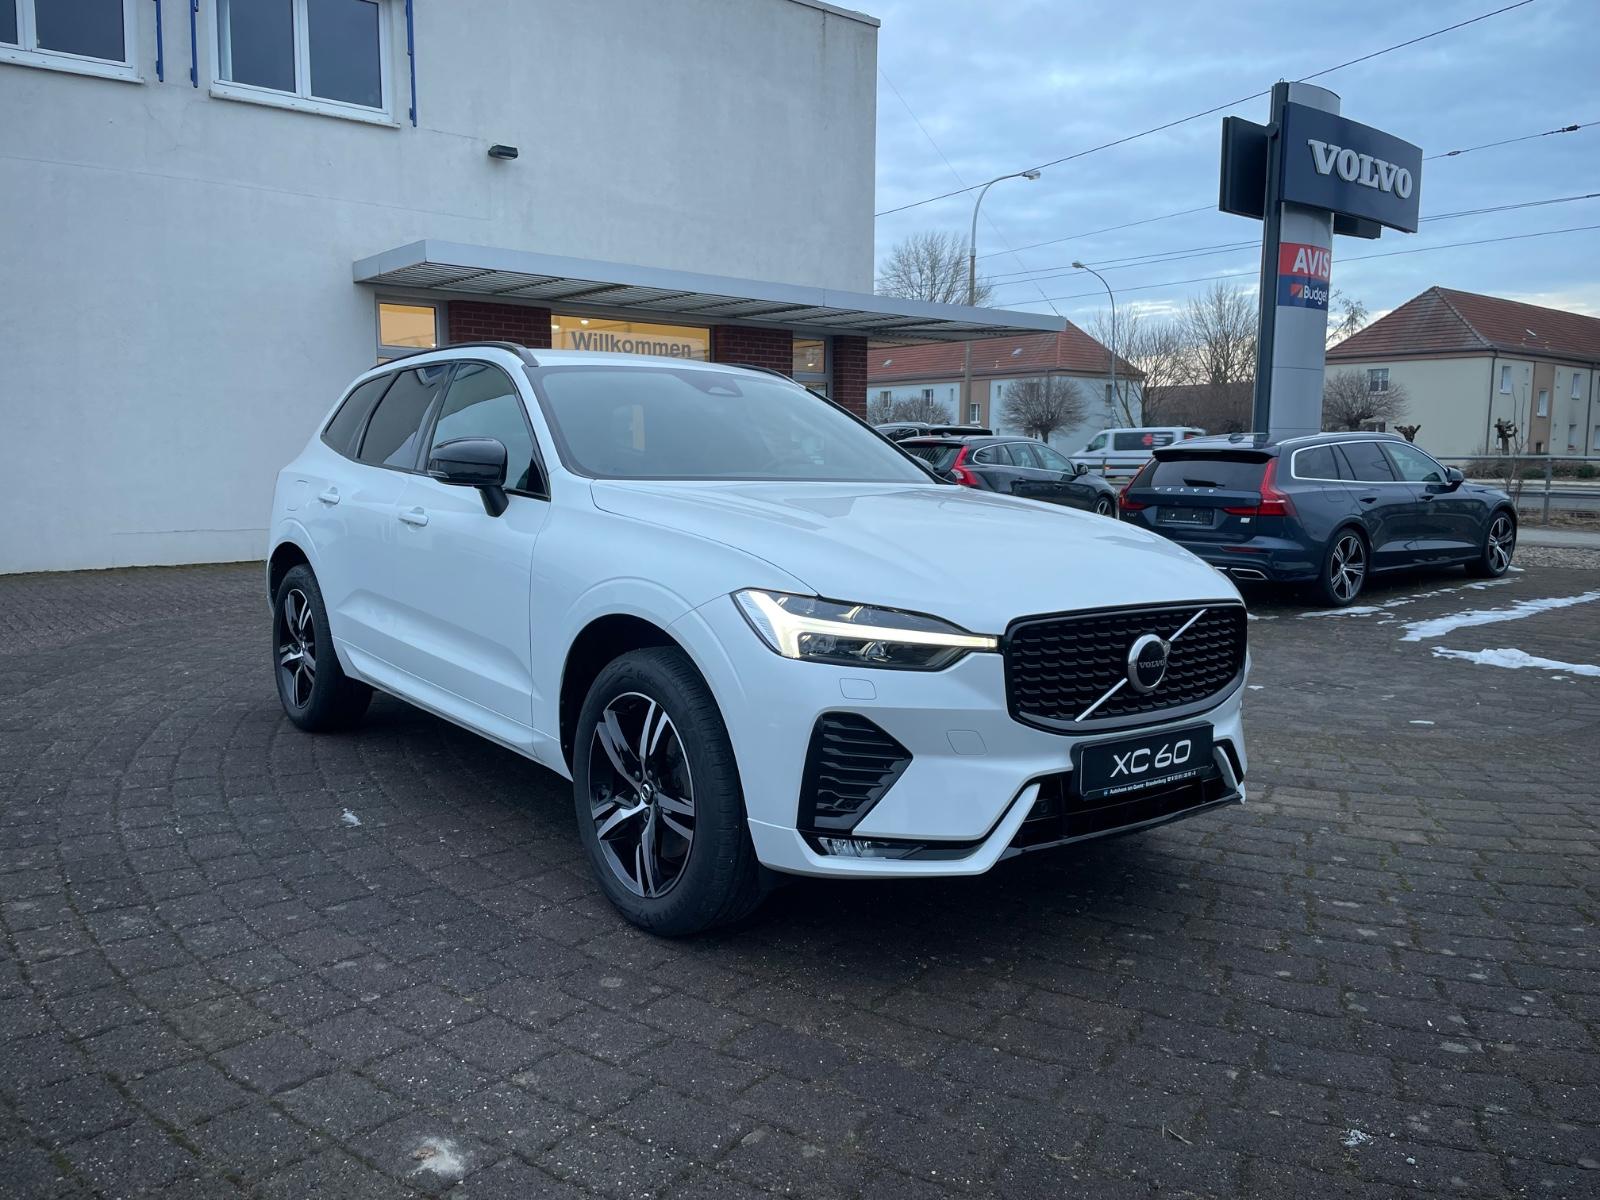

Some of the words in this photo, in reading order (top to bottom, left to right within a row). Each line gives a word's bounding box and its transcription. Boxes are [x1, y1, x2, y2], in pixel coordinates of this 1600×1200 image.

[1307, 139, 1413, 199] VOLVO
[1292, 247, 1330, 278] AVIS
[571, 331, 692, 357] Willkommen
[1139, 660, 1165, 669] VOLVO
